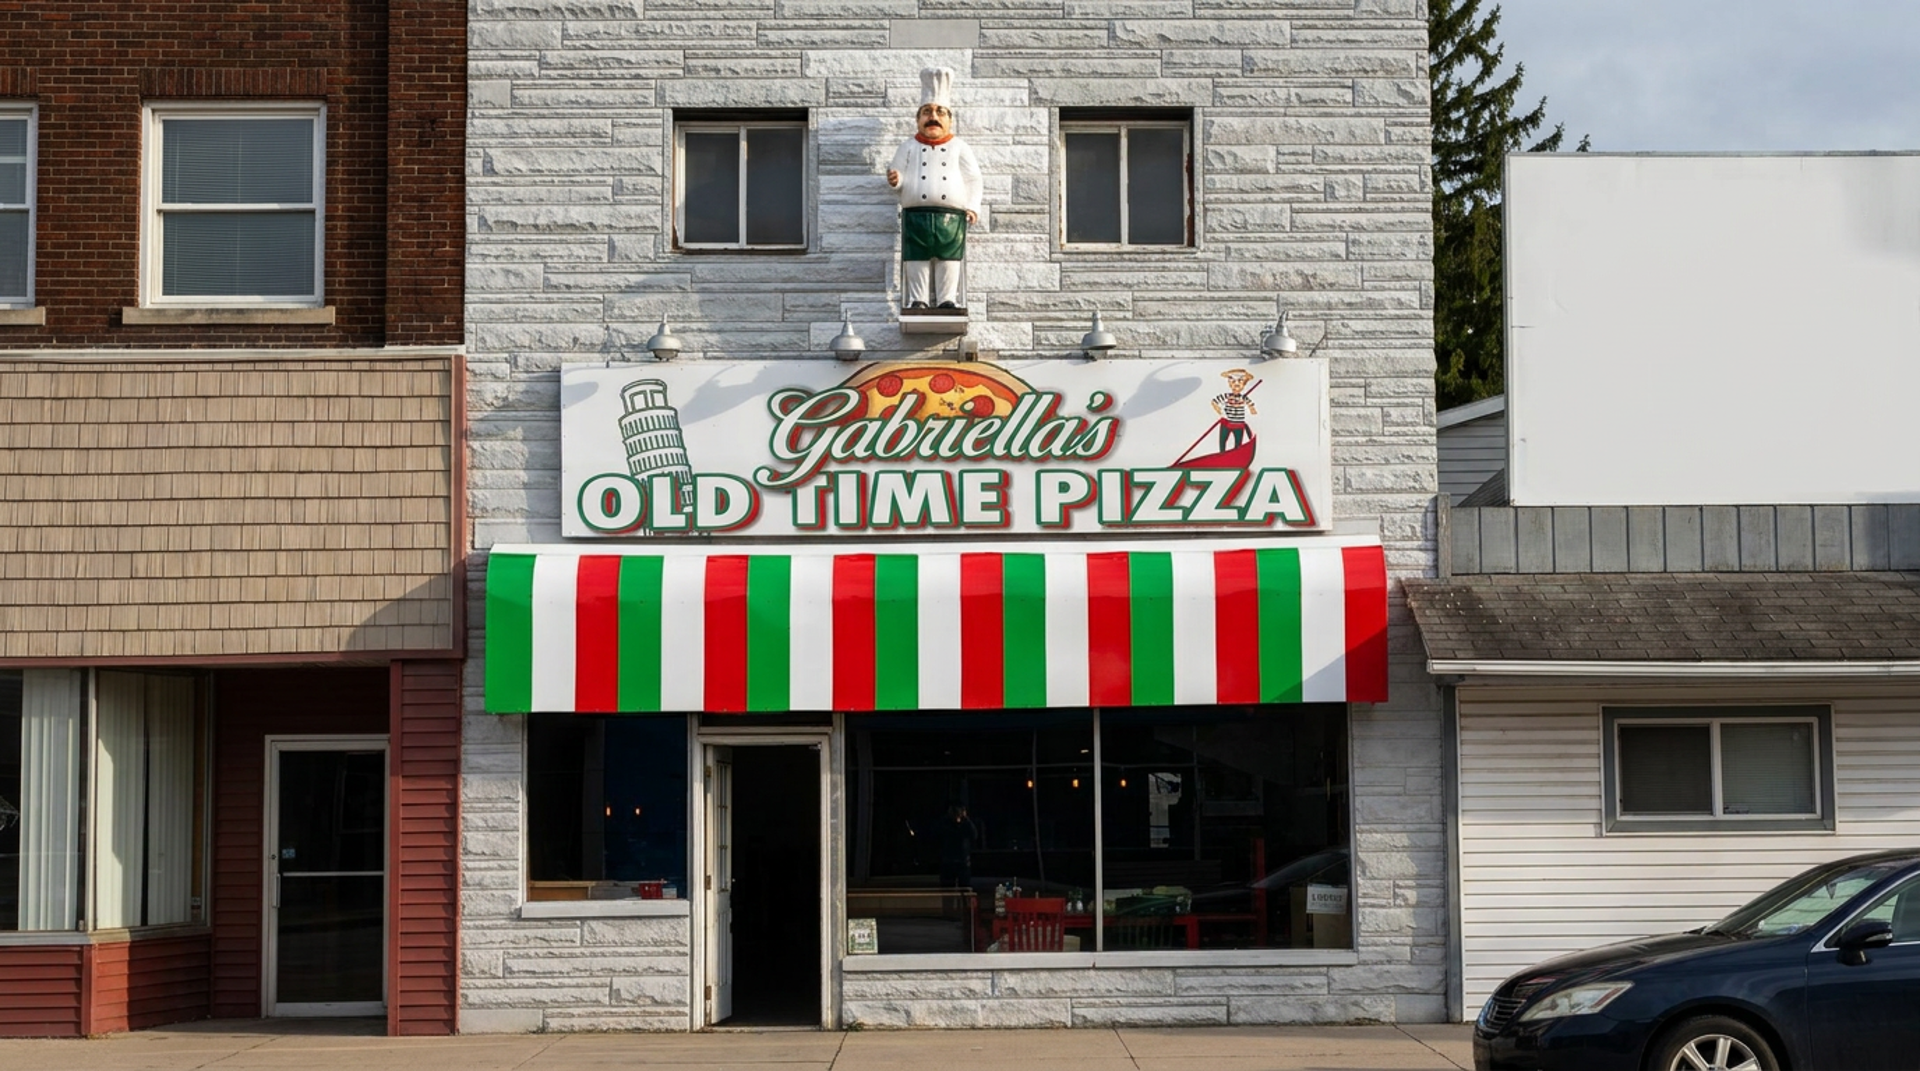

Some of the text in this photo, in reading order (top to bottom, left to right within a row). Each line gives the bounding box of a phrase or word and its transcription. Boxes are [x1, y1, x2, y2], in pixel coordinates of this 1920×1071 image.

[754, 387, 1119, 488] Gabriella's
[577, 467, 1316, 534] OLD TIME PIZZA
